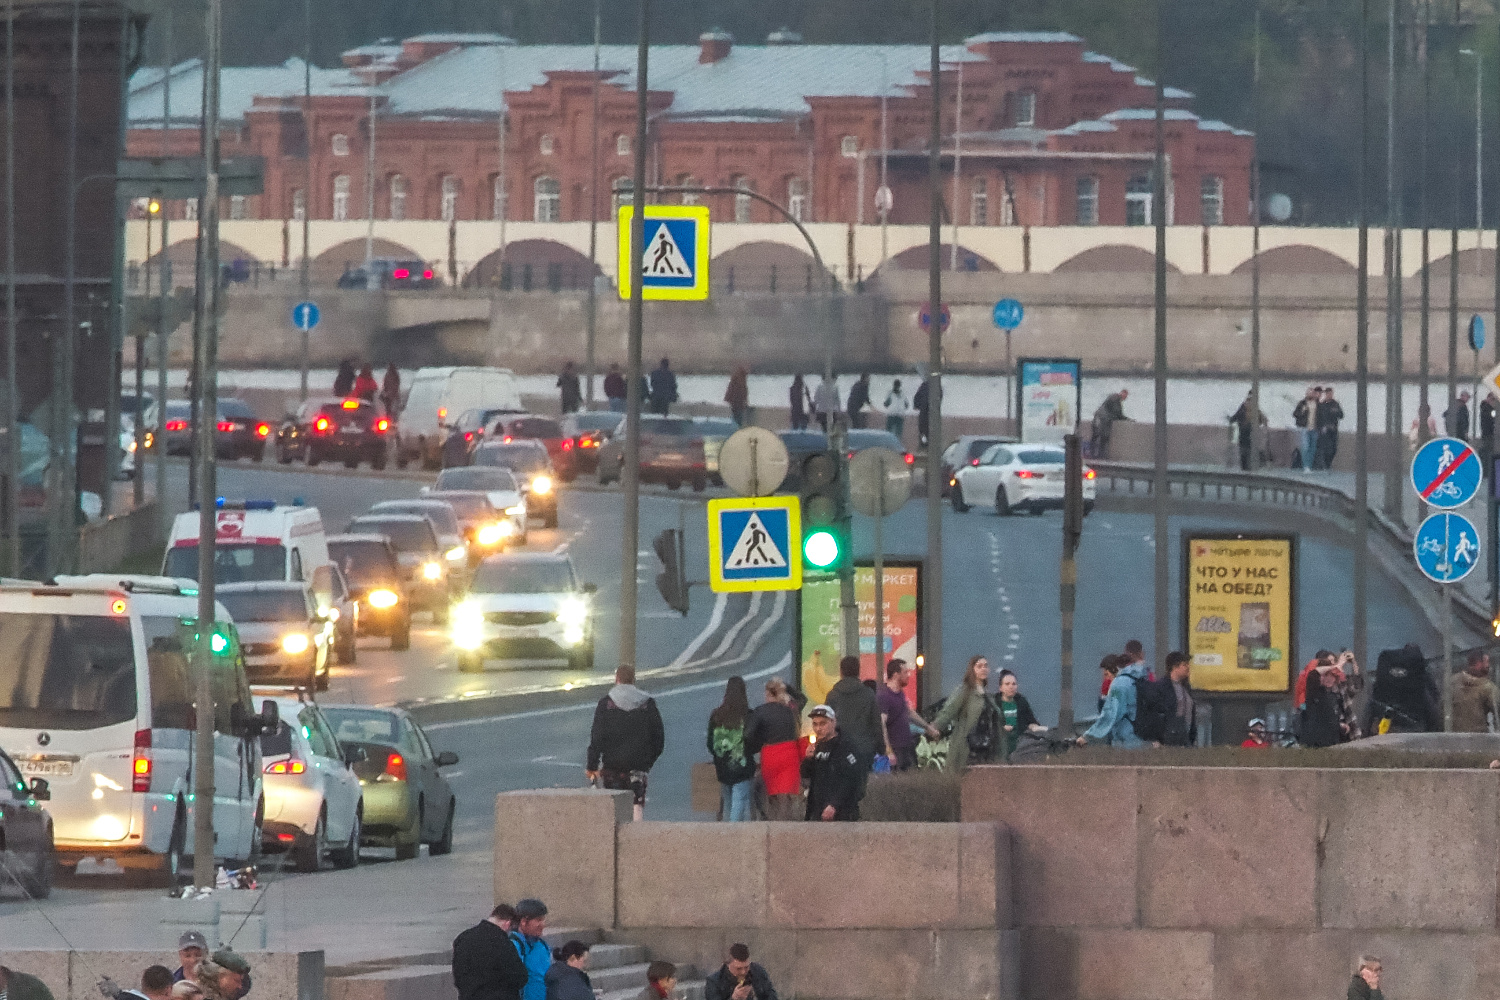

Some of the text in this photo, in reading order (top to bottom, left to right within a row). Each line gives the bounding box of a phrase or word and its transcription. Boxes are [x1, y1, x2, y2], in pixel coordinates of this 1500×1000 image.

[1196, 566, 1278, 579] ЧТО У НАС
[860, 574, 915, 585] МРКЕТ
[1196, 582, 1273, 596] НА ОБЕД?
